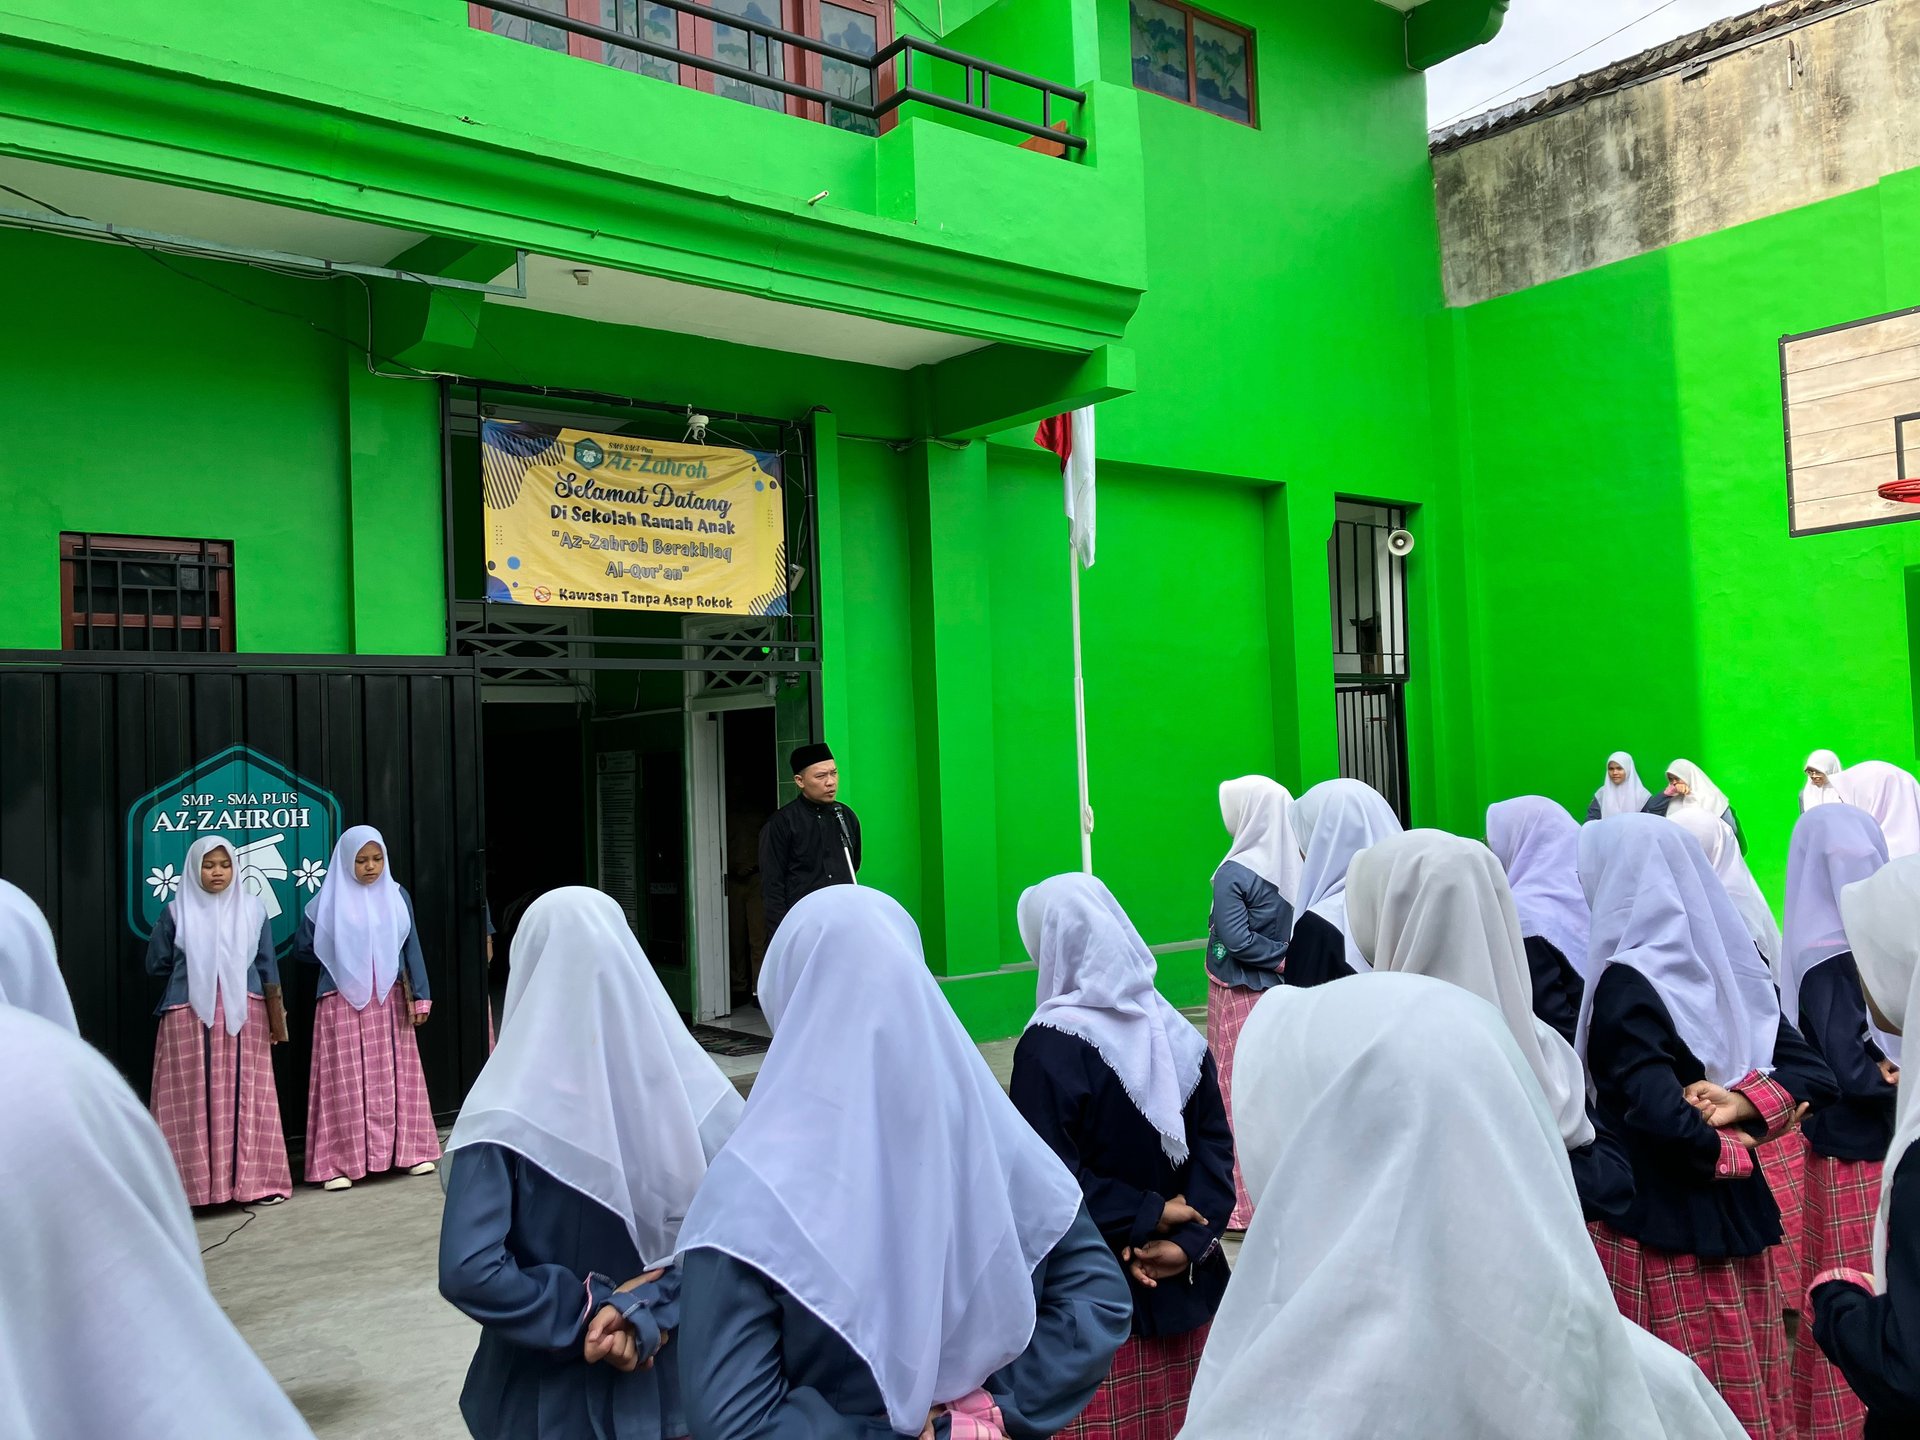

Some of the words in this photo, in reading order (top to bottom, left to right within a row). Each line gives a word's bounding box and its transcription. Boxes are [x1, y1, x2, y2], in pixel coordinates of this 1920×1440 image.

[604, 451, 708, 479] Az-Zahroh
[554, 471, 649, 504] Selamat
[652, 483, 732, 519] Datang
[550, 505, 567, 520] Di
[571, 505, 637, 526] Sekolah
[640, 512, 693, 531] Ramah
[698, 519, 736, 535] Anak
[551, 530, 648, 553] "Az-Zahroh
[653, 539, 732, 563] Berakhlaq
[605, 561, 689, 580] Al-Qur'an"
[559, 588, 618, 602] Kawasan
[622, 591, 660, 607] Tanpa
[663, 594, 693, 609] Asap
[697, 595, 733, 609] Rokok
[182, 794, 214, 806] SMP
[227, 793, 258, 805] SMA
[262, 792, 298, 804] PLUS
[152, 808, 310, 832] AZ-ZAHROH
